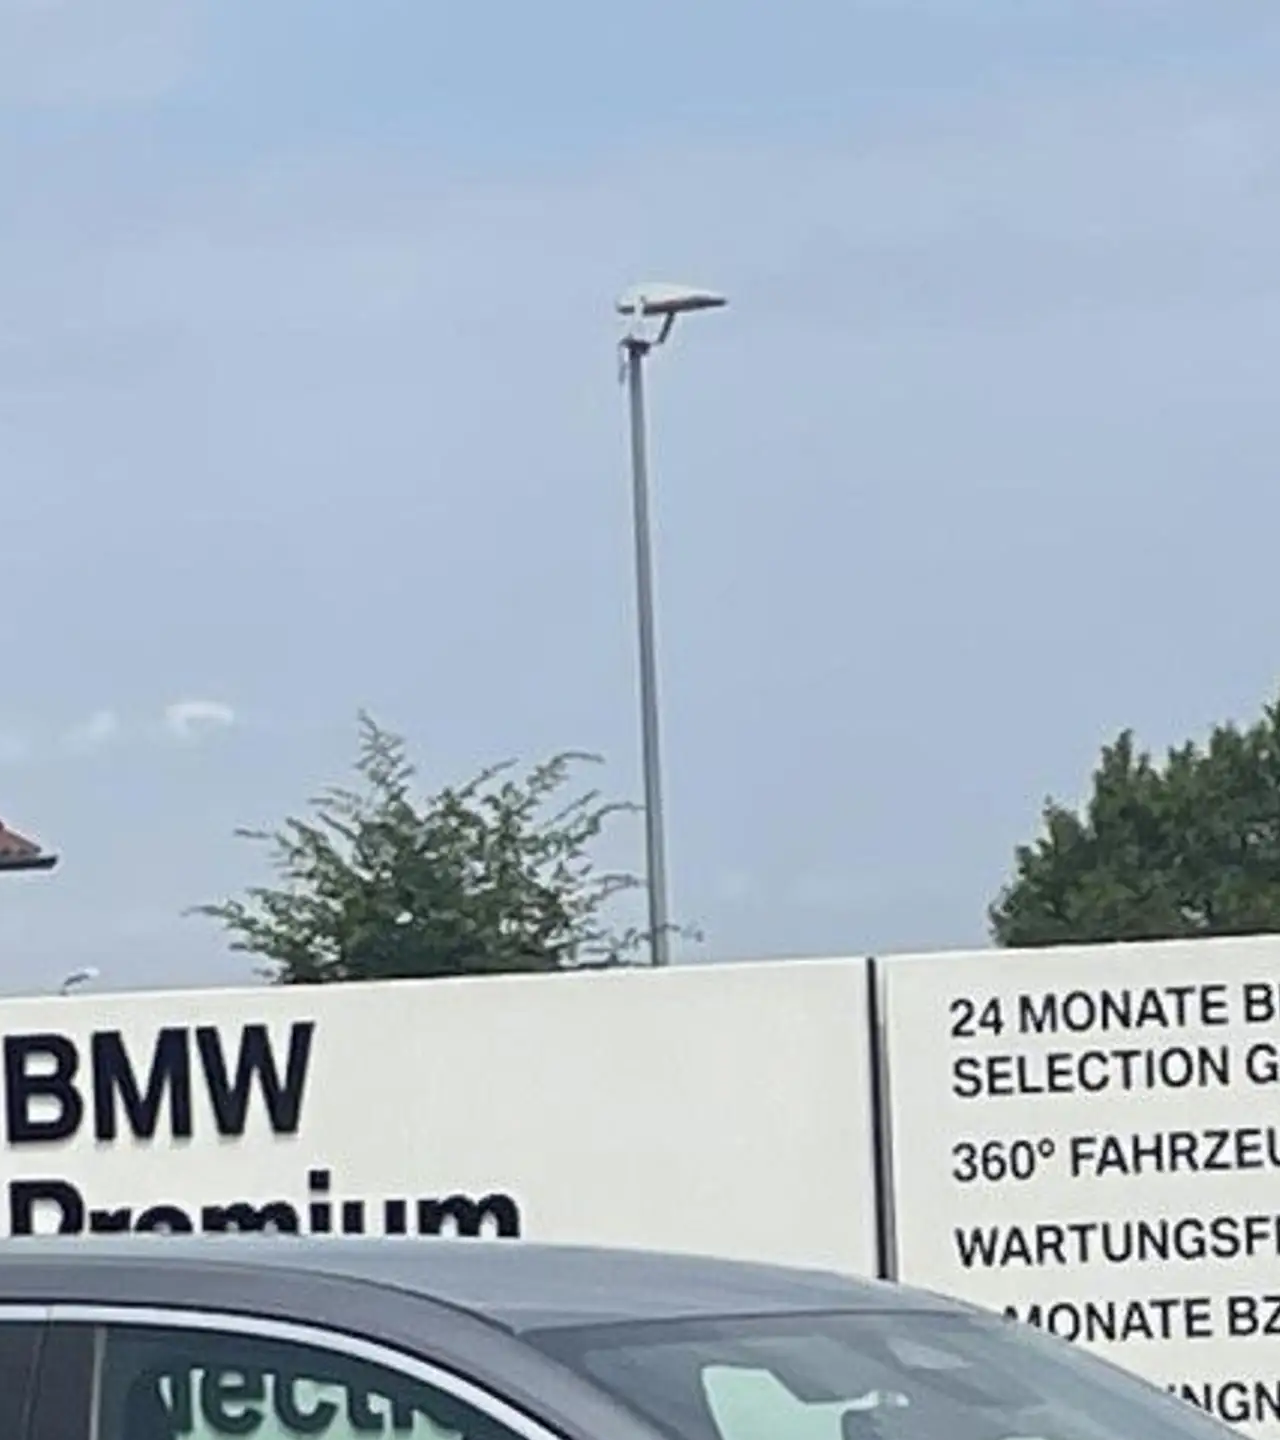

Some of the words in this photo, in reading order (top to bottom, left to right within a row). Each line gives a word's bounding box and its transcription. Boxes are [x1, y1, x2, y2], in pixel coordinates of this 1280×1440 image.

[949, 997, 1004, 1037] 24
[1019, 984, 1229, 1034] MONATE
[3, 1021, 315, 1145] BMW
[952, 1045, 1230, 1098] SELECTION
